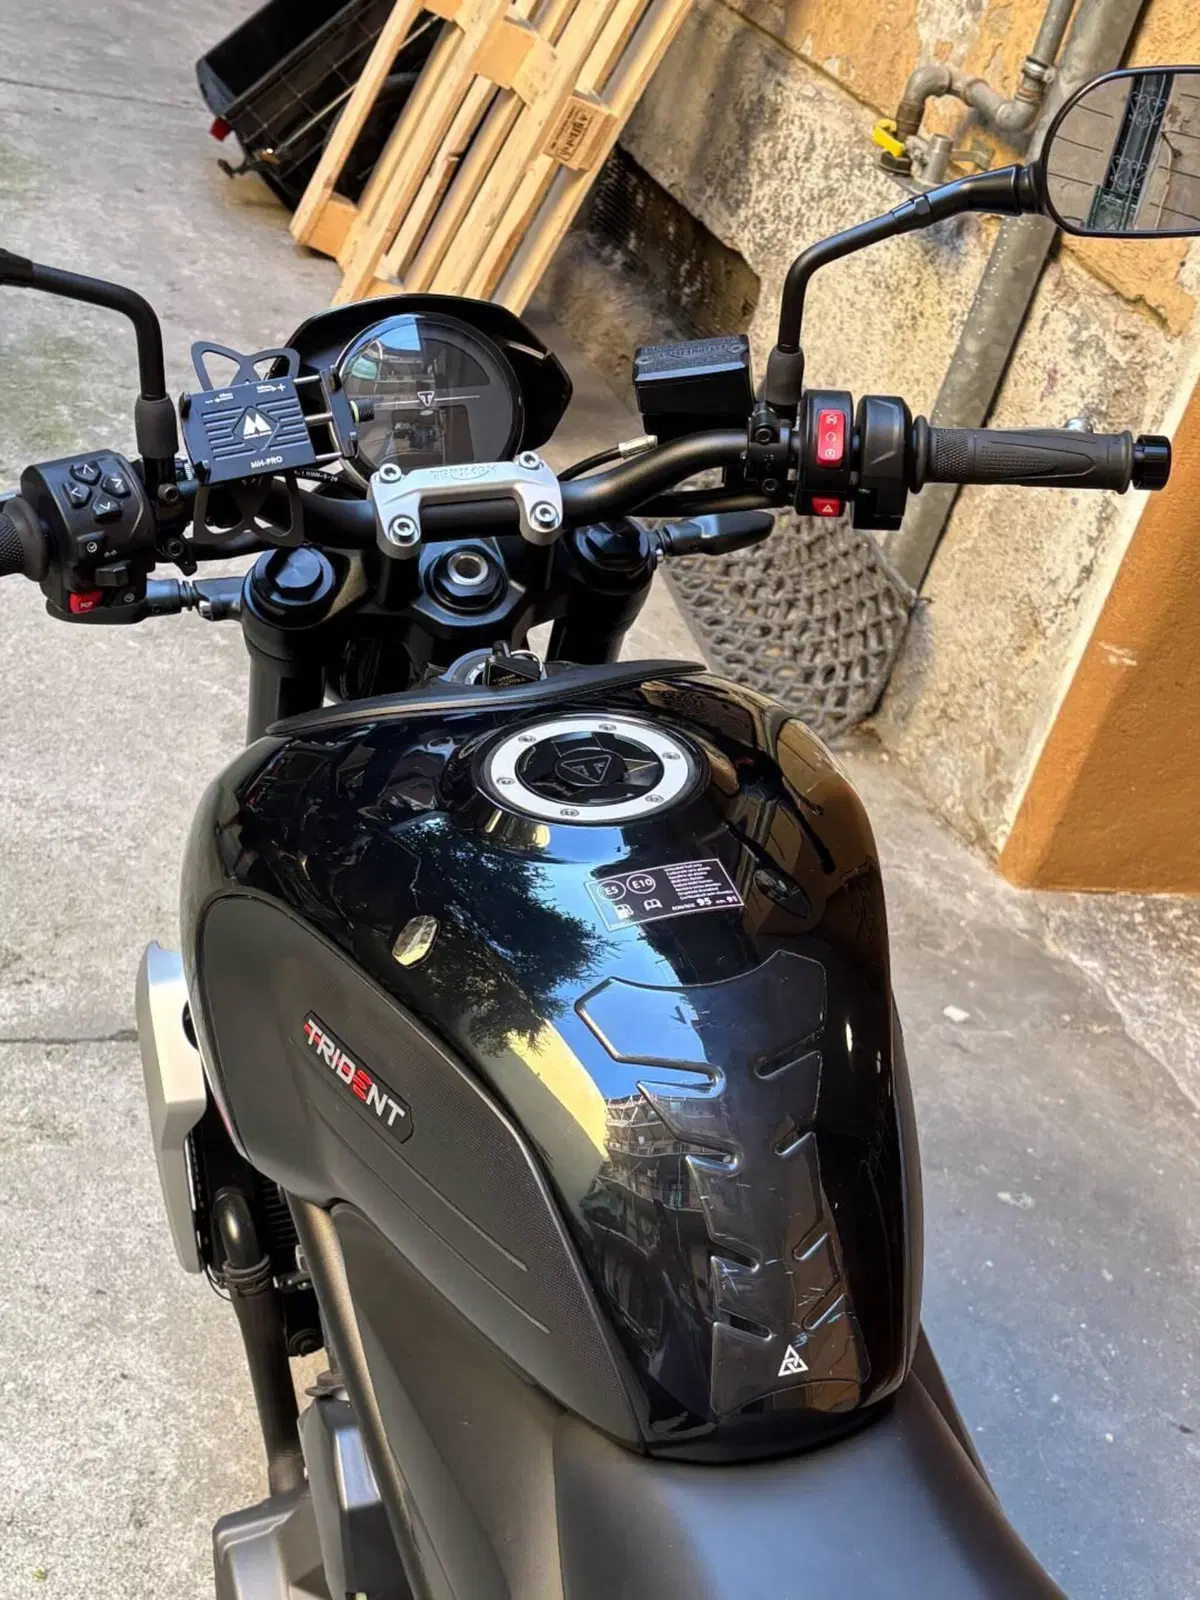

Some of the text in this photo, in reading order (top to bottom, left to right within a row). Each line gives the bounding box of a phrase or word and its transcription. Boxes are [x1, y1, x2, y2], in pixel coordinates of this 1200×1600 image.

[250, 456, 283, 469] MH-PRO
[604, 879, 653, 896] E5 E10
[696, 897, 712, 907] 95
[303, 1018, 406, 1127] TRIDENT
